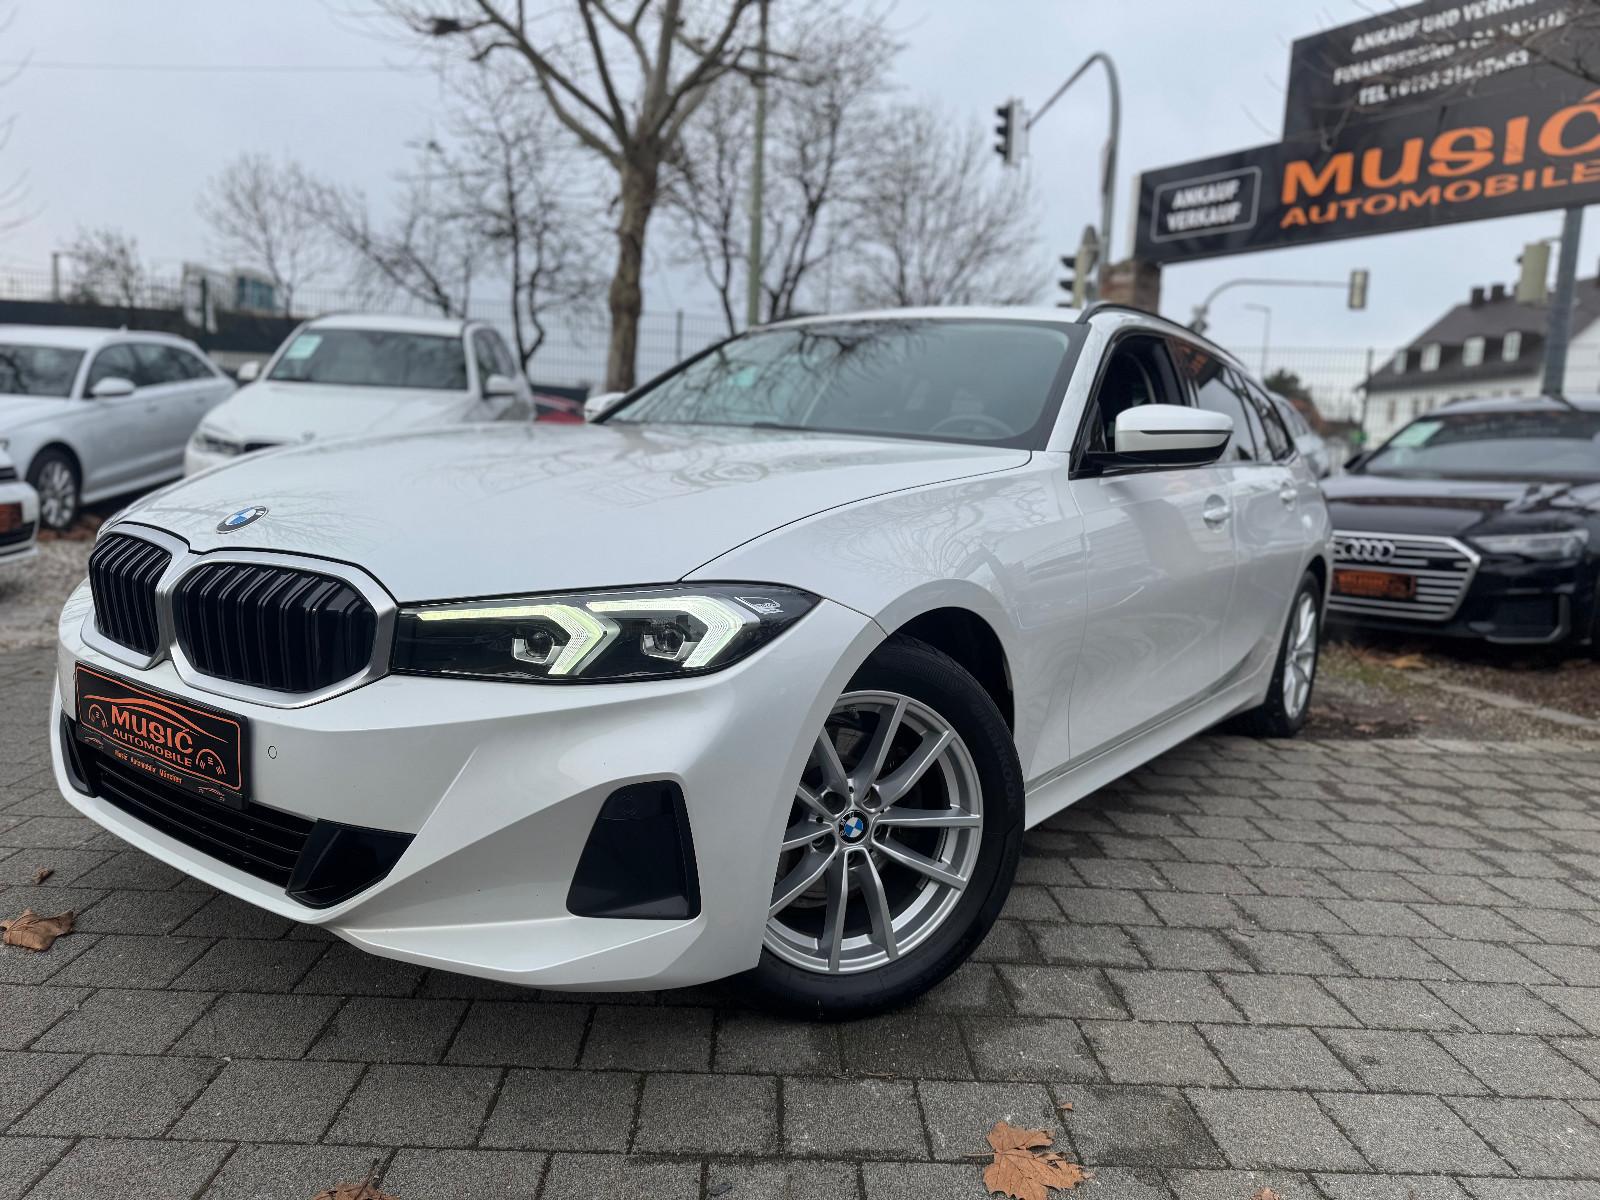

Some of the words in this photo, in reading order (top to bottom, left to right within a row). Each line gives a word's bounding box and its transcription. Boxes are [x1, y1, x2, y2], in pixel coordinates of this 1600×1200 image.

[1352, 18, 1420, 54] ANKAUF
[1422, 8, 1461, 33] UND
[1171, 179, 1240, 210] ANKAUF
[1280, 160, 1600, 228] AUTOMOBILE
[1166, 201, 1242, 232] VERKAUF
[112, 728, 193, 767] AUTOMOBILE
